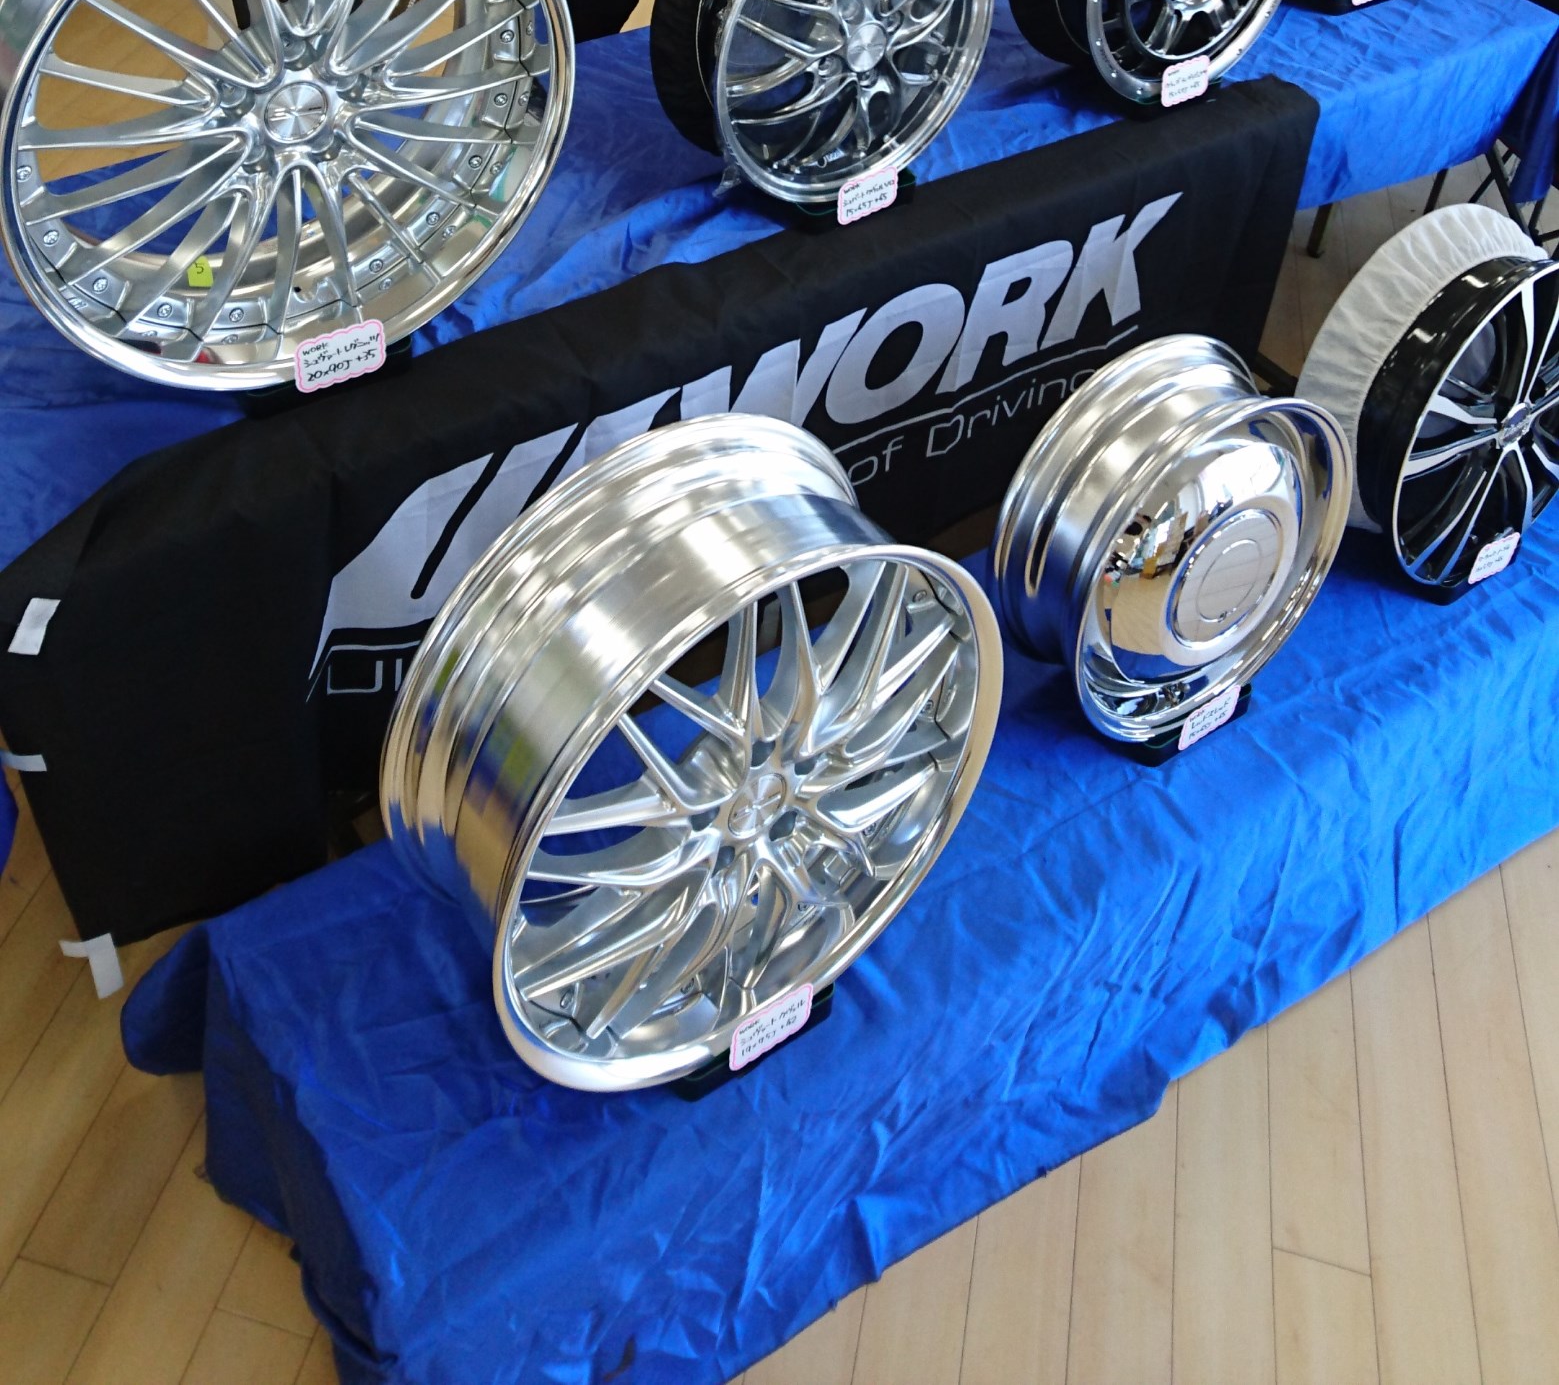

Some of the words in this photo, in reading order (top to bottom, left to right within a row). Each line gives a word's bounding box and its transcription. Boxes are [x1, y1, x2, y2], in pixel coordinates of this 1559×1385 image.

[679, 191, 1183, 428] WORK
[302, 341, 330, 356] WORK
[847, 435, 905, 487] of
